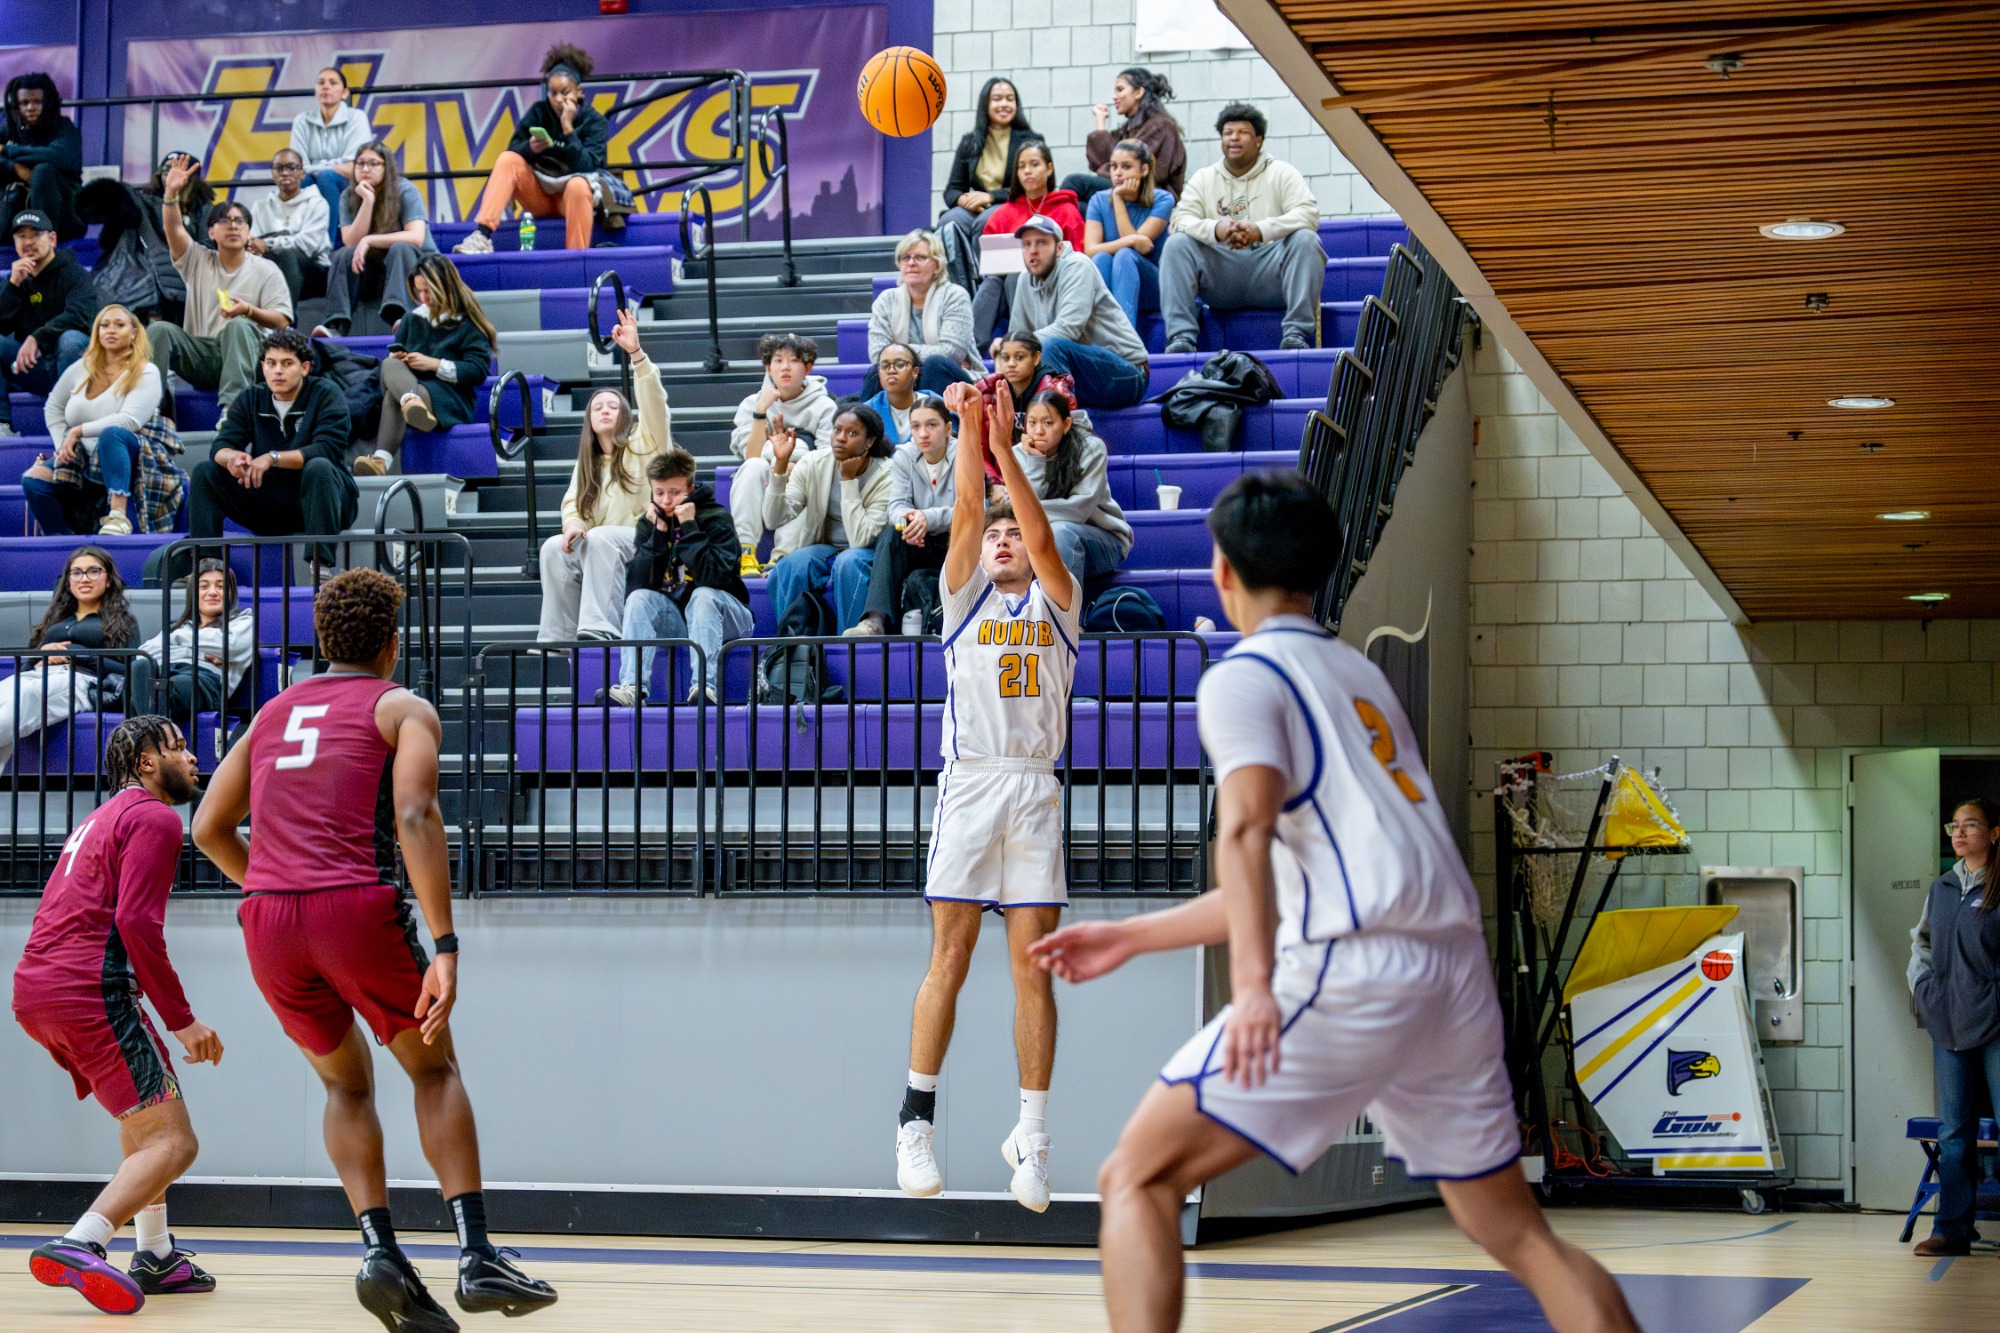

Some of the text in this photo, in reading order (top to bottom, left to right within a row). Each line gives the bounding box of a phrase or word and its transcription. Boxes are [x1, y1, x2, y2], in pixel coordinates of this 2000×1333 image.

[999, 653, 1040, 698] 21
[275, 704, 331, 771] 5
[64, 818, 96, 878] 4
[1652, 1115, 1723, 1134] GUN
[1661, 1110, 1679, 1118] THE
